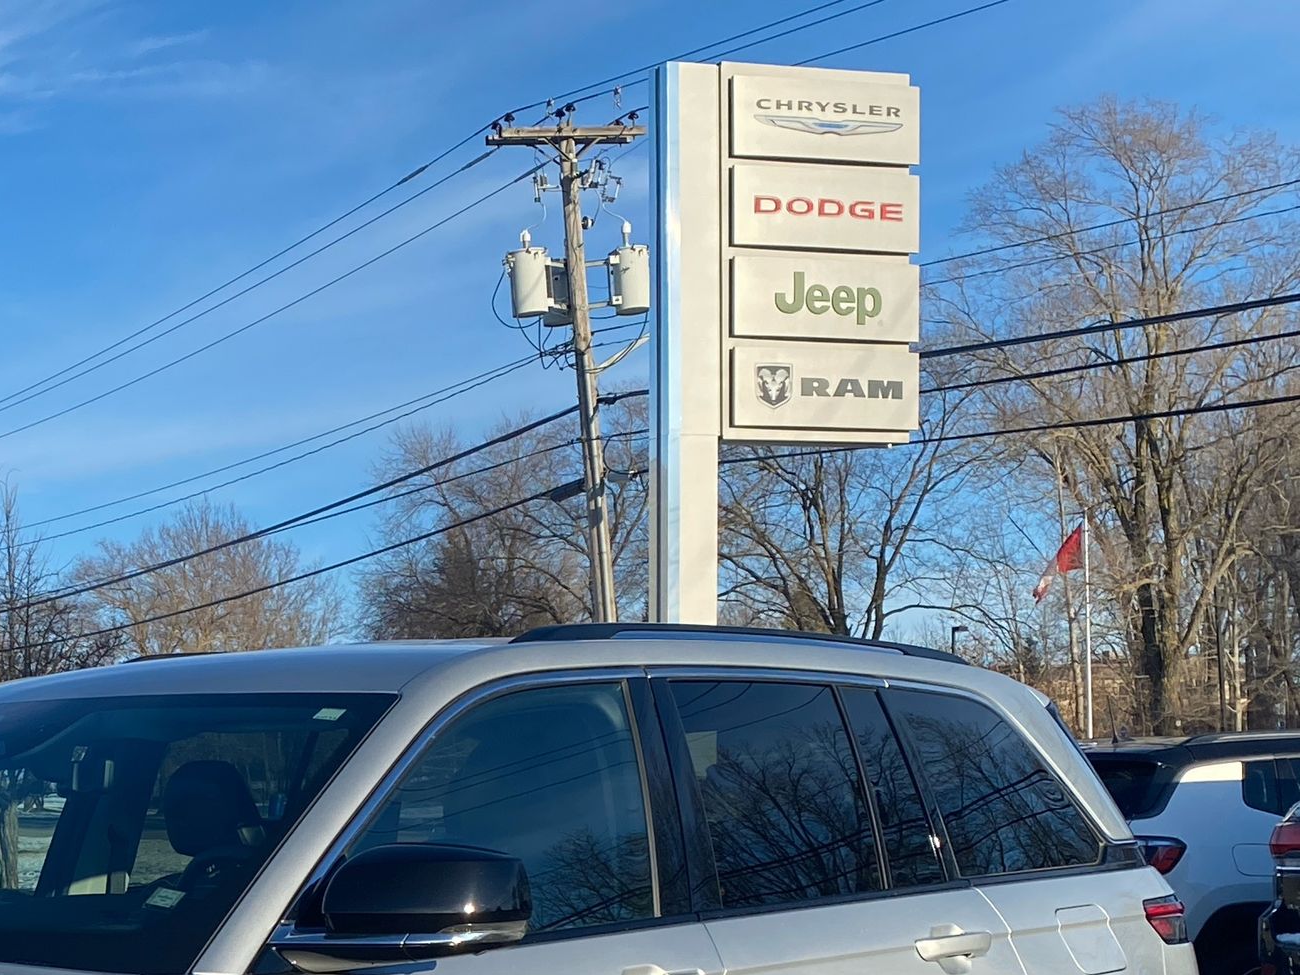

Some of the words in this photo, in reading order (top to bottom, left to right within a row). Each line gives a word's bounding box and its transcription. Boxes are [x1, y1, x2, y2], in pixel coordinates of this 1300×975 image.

[755, 98, 901, 119] CHRYSLER
[753, 195, 904, 223] DODGE
[774, 271, 883, 325] Jeep
[800, 376, 903, 400] RAM
